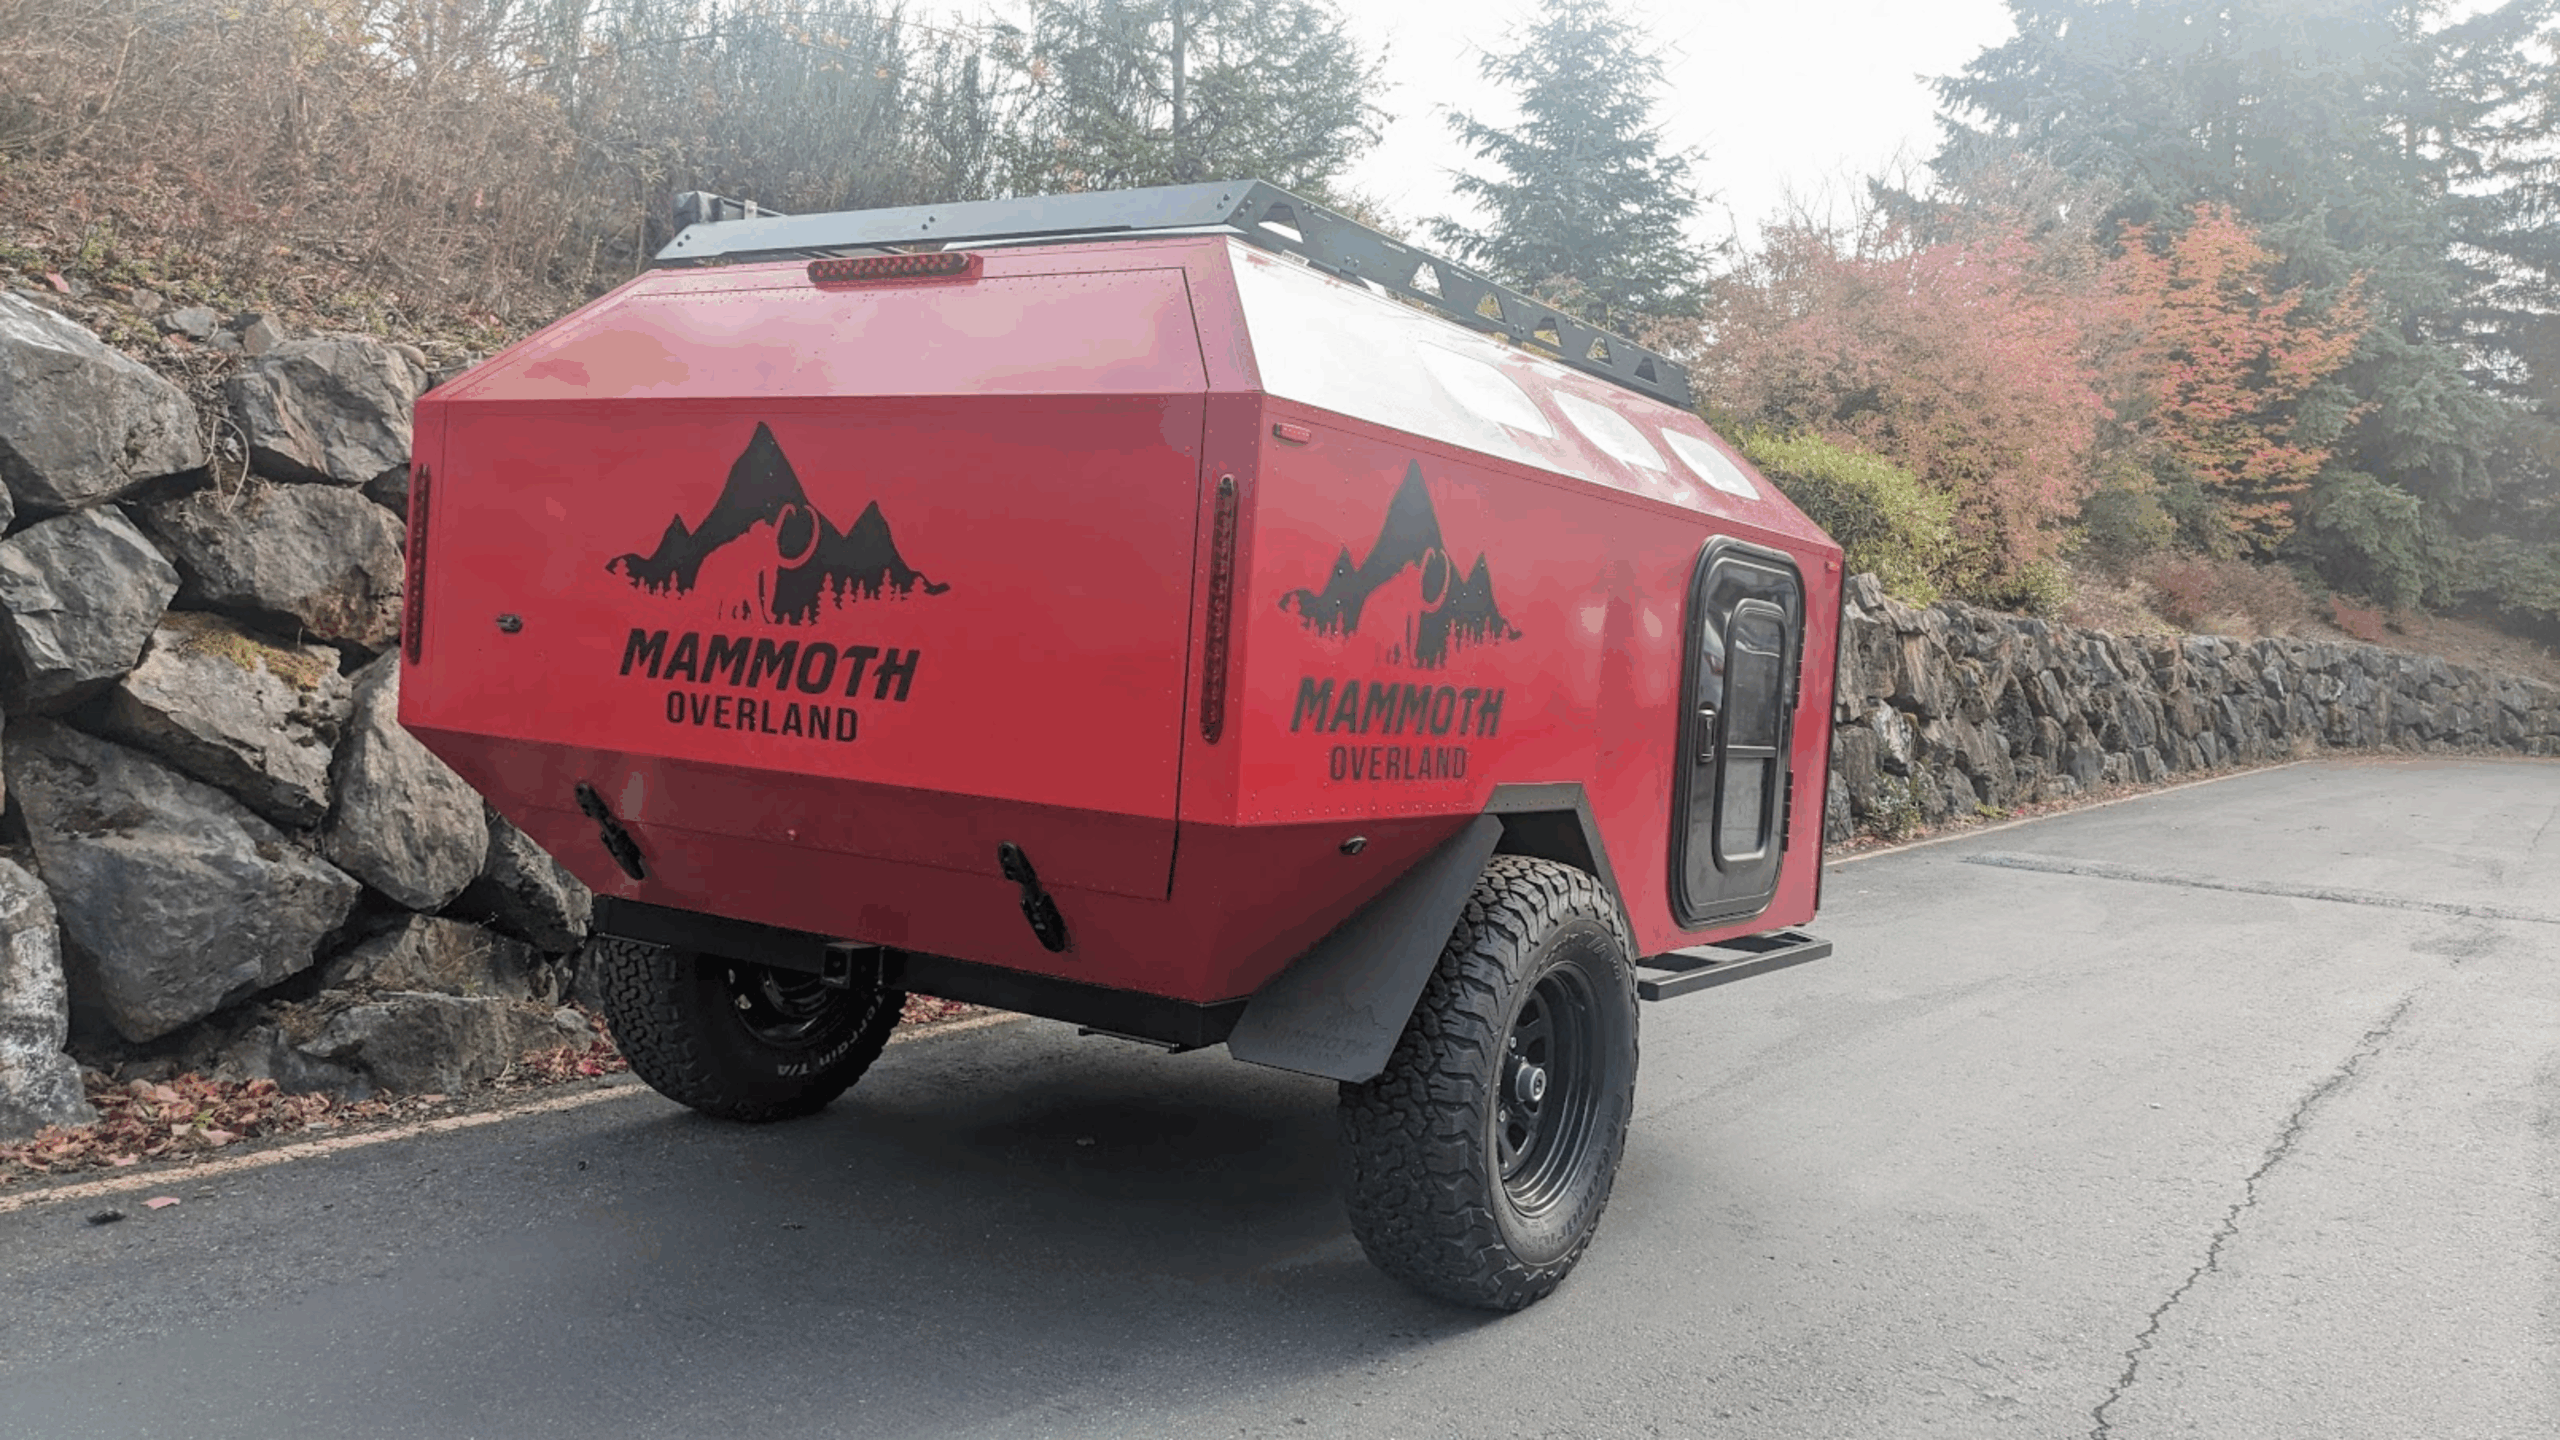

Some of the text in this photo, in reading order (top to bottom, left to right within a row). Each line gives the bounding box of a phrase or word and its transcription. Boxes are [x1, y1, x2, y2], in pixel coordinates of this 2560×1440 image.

[619, 628, 920, 702] MAMMOTH
[666, 690, 858, 743] OVERLAND
[1289, 676, 1505, 738] MAMMOTH
[1329, 745, 1467, 781] OVERLAND
